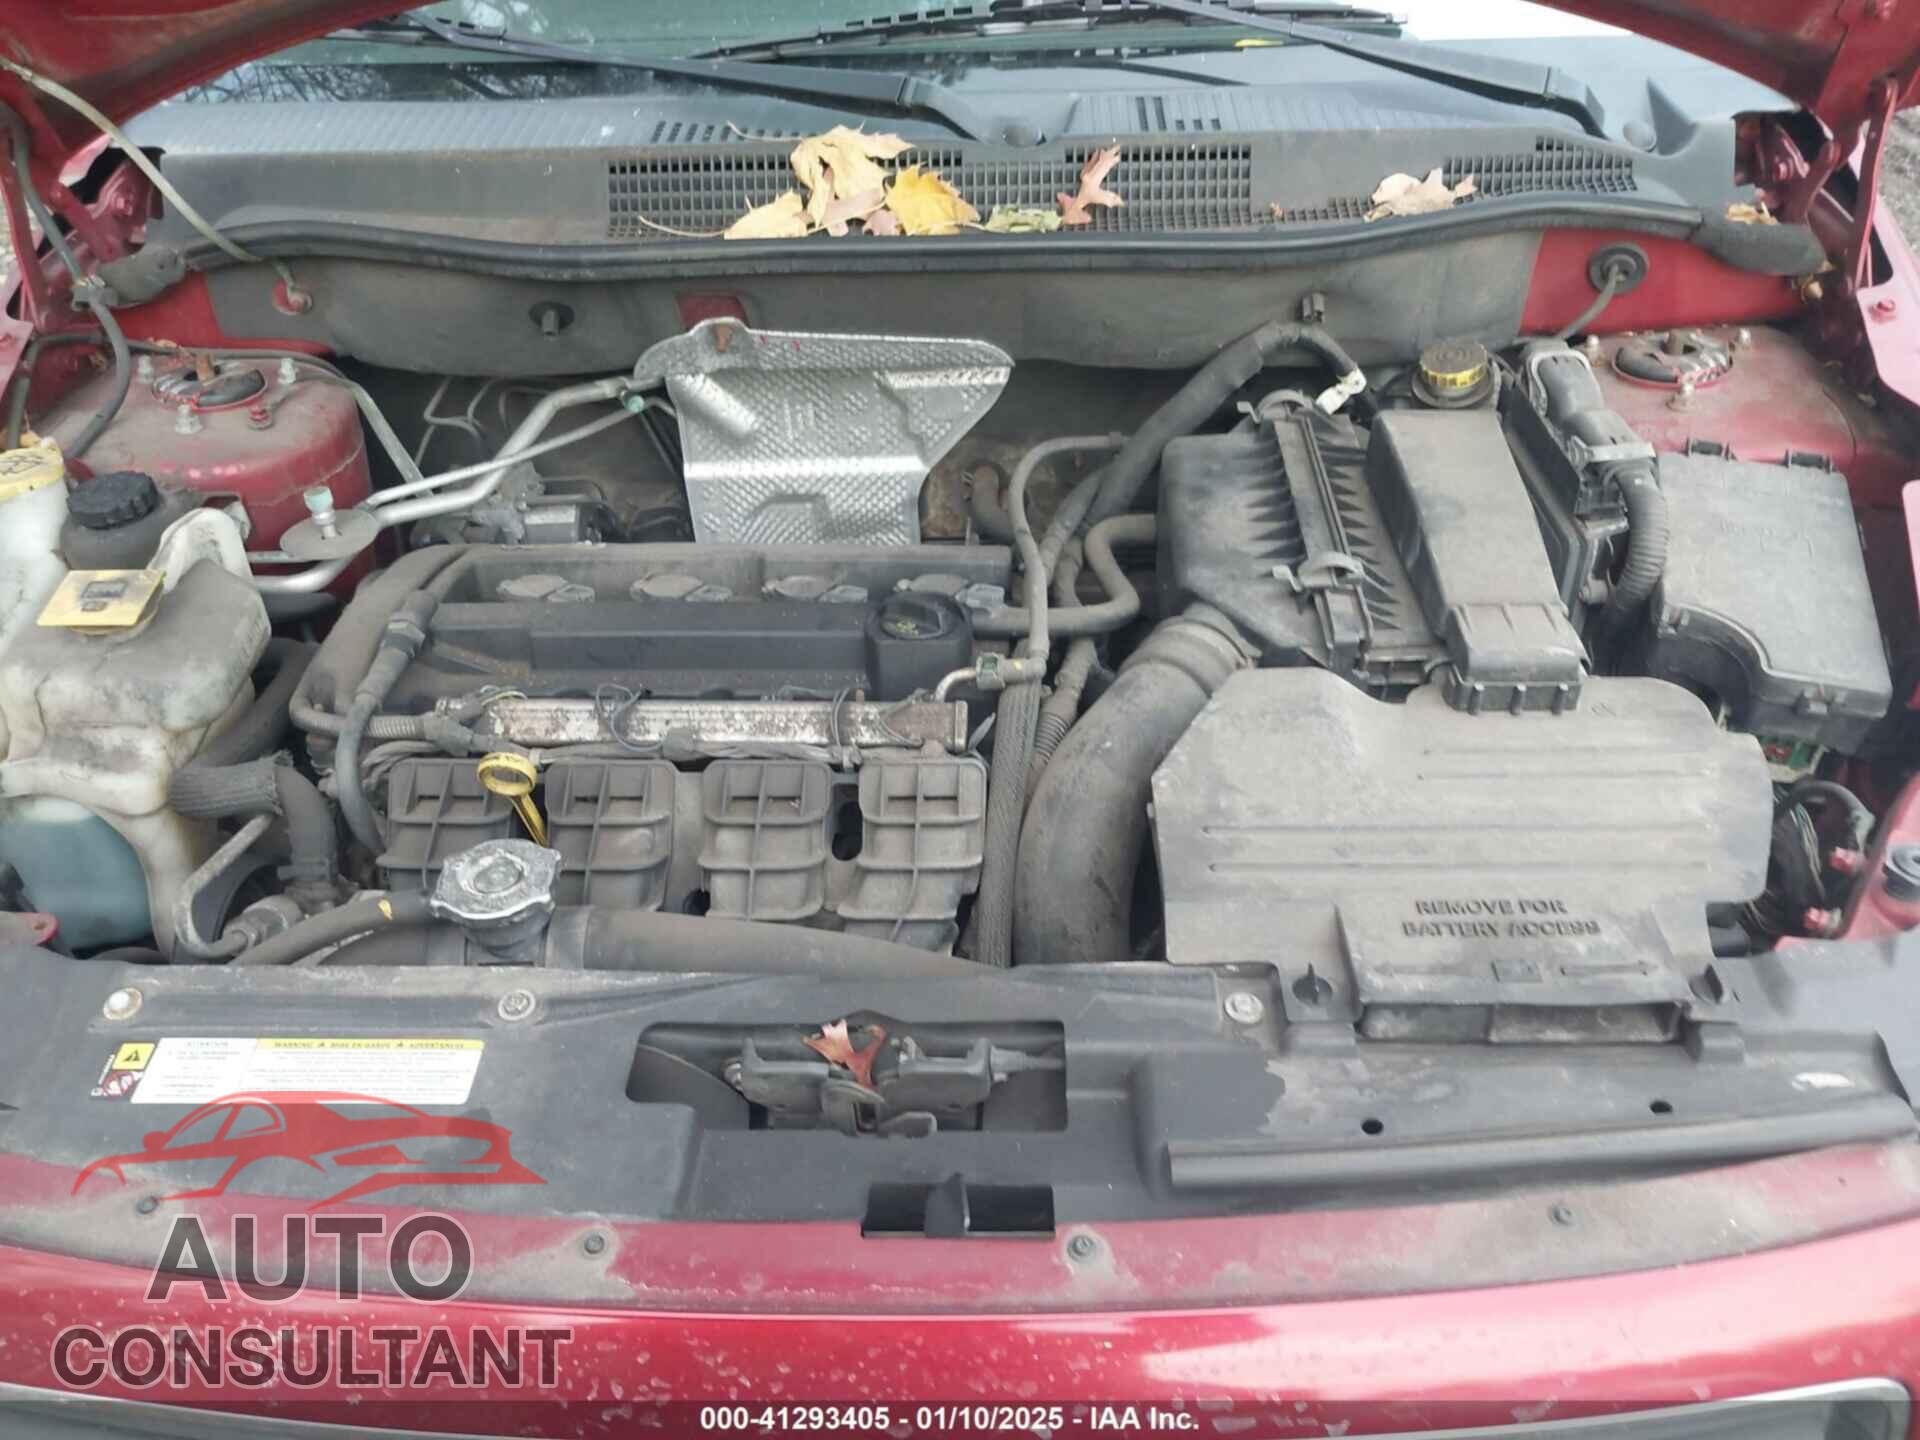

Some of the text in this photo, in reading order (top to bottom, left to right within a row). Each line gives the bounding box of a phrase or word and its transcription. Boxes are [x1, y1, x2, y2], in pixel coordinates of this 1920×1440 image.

[1414, 898, 1568, 916] REMOVE FOR
[1401, 919, 1602, 938] BATTERY ACCESS
